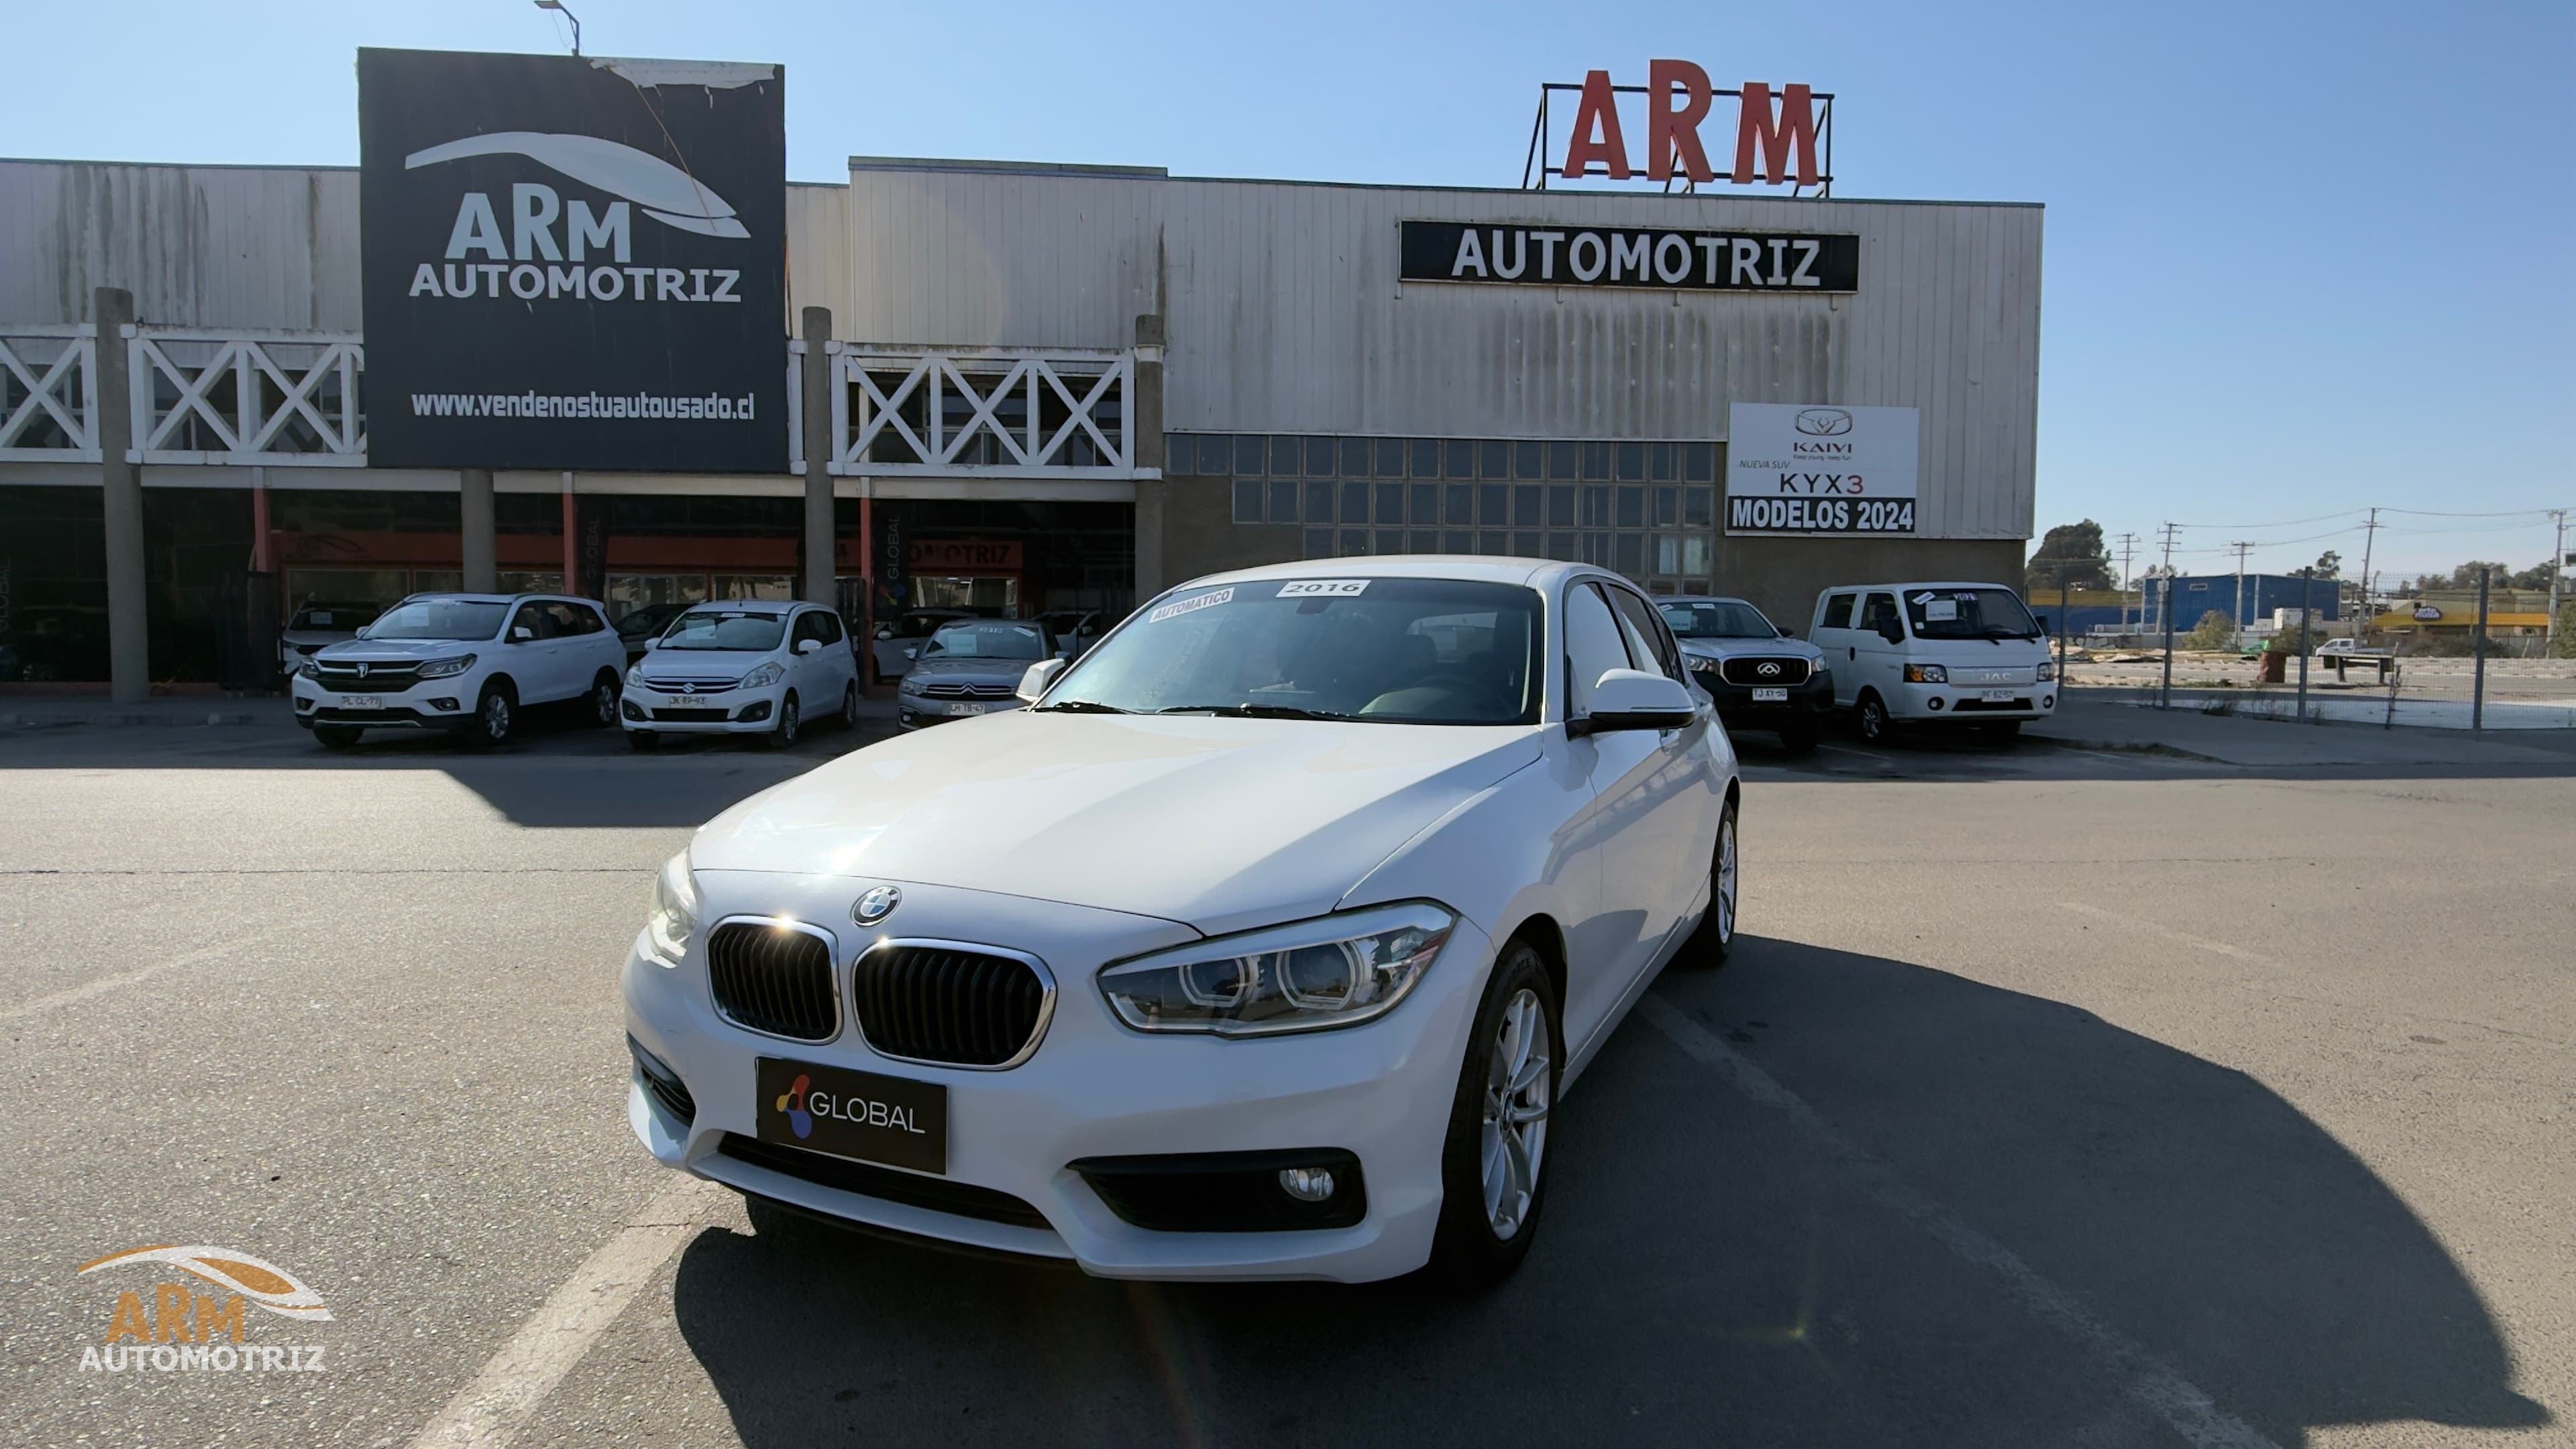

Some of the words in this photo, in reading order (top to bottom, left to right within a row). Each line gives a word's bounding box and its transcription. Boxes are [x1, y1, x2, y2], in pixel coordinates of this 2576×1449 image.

[1562, 58, 1818, 186] ARM
[445, 182, 631, 263] ARM
[1450, 229, 1821, 286] AUTOMOTRIZ
[409, 264, 741, 303] AUTOMOTRIZ
[411, 390, 755, 420] www.vendenostuautousado.cl
[1739, 460, 1770, 469] NUEVA
[1772, 461, 1790, 469] SUV
[1779, 473, 1864, 494] KYX3
[1732, 499, 1849, 530] MODELOS
[1856, 502, 1913, 530] 2024
[888, 513, 902, 580] GLOBAL
[1285, 582, 1360, 593] 2016
[1980, 672, 2012, 681] JAC
[809, 1091, 926, 1134] GLOBAL
